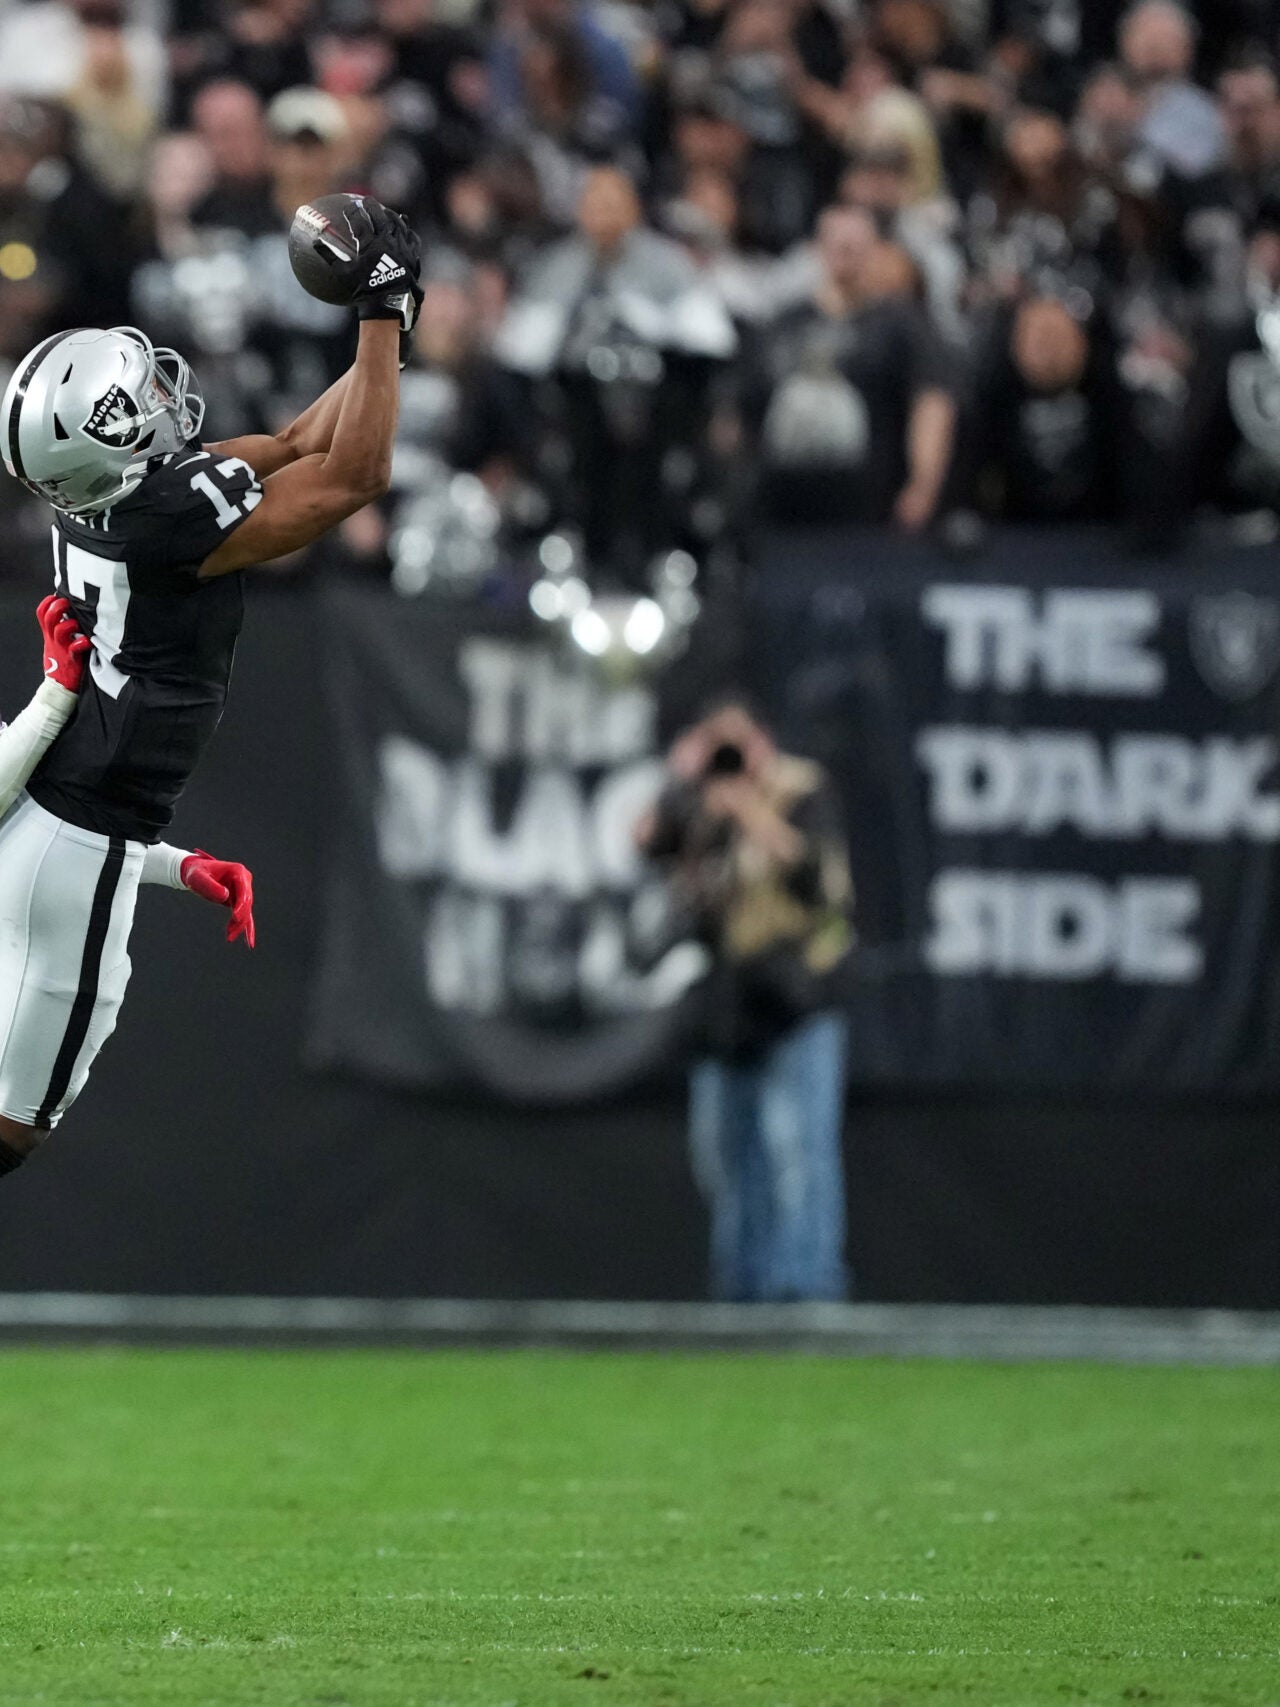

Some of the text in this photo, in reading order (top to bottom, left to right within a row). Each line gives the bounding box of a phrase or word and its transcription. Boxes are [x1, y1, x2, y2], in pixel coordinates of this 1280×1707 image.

[368, 267, 406, 287] adidas
[922, 583, 1166, 696] THE
[376, 732, 670, 897] BLAC
[917, 724, 1280, 842] DARK
[924, 866, 1206, 985] SIDE
